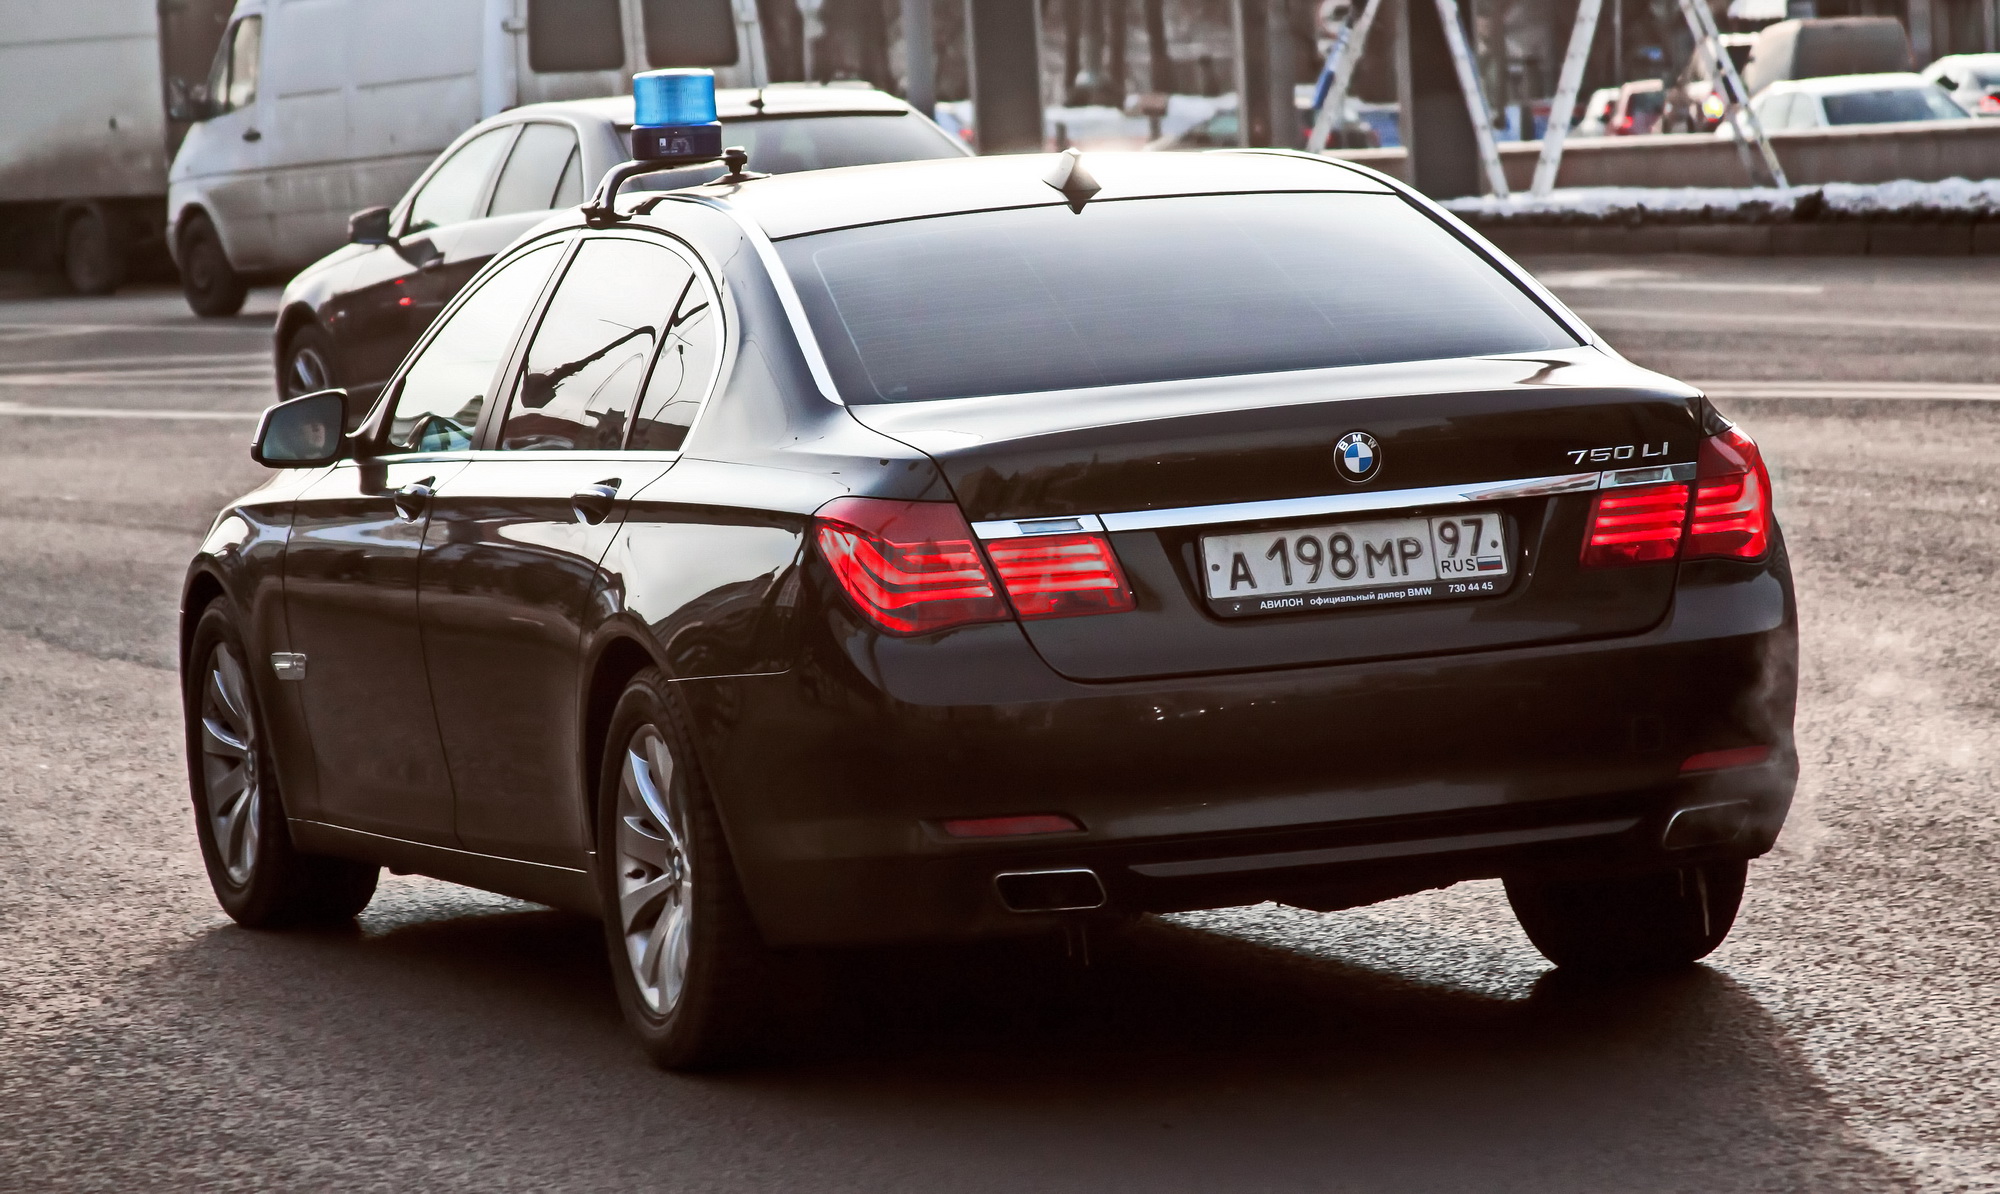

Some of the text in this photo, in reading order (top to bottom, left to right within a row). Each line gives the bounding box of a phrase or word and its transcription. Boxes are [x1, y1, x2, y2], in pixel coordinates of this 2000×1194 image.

[1337, 433, 1377, 452] BMW
[1567, 446, 1634, 465] 750
[1438, 518, 1483, 558] 97
[1440, 558, 1476, 573] RUS
[1260, 581, 1494, 610] АВИЛОН официальный дилер BMW 730 44 45
